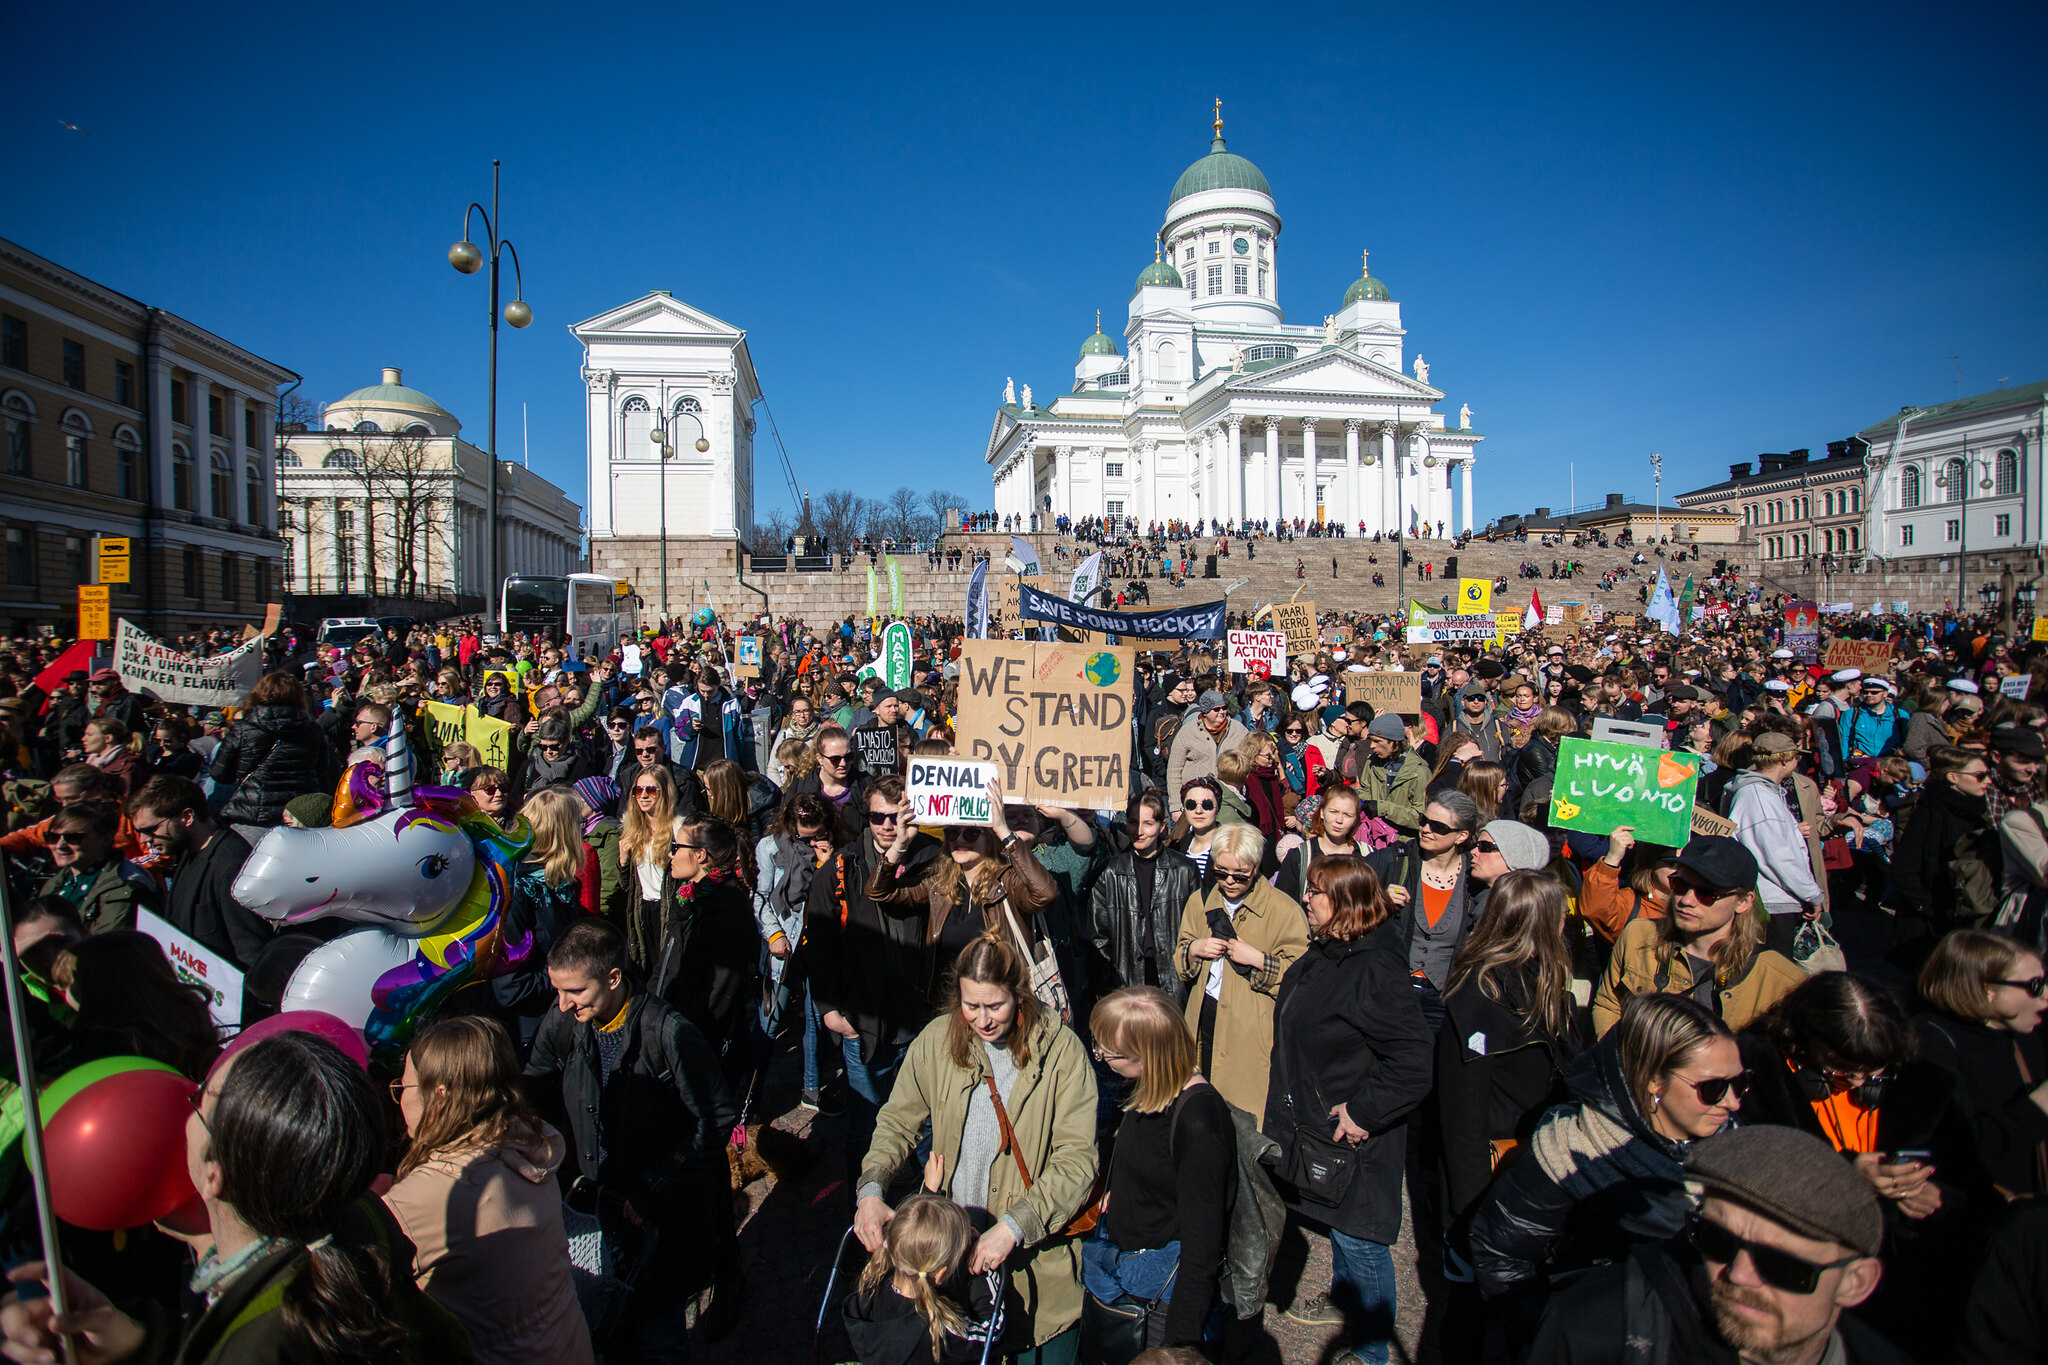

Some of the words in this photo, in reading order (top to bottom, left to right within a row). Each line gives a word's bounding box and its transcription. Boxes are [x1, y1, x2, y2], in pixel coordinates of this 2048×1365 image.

[1006, 598, 1021, 607] AIK
[1005, 611, 1021, 621] KÄY
[1029, 595, 1072, 621] SAVE
[1076, 611, 1128, 631] POND
[1133, 612, 1219, 633] HOCKEY
[1414, 609, 1427, 620] OL
[1444, 613, 1487, 622] KUUDES
[1280, 617, 1309, 630] KERRO
[1427, 620, 1496, 630] JOUKKOSUKUPUUTTO
[1230, 632, 1285, 648] CLIMATE
[1434, 629, 1450, 640] ON
[1234, 646, 1278, 659] ACTION
[158, 659, 204, 675] UHKAA
[965, 656, 1026, 698] WE
[1348, 675, 1368, 687] NYT
[1370, 675, 1420, 687] TARVITAAN
[1355, 686, 1402, 702] TOIMIA!
[998, 692, 1126, 737] STAND
[1034, 746, 1123, 793] GRETA
[1574, 752, 1644, 776] HYVÄ
[911, 764, 985, 789] DENIAL
[1570, 779, 1686, 812] LUONTO
[928, 794, 953, 817] NOT
[952, 796, 959, 816] A
[959, 795, 991, 817] POLICY
[171, 942, 208, 978] MAKE
